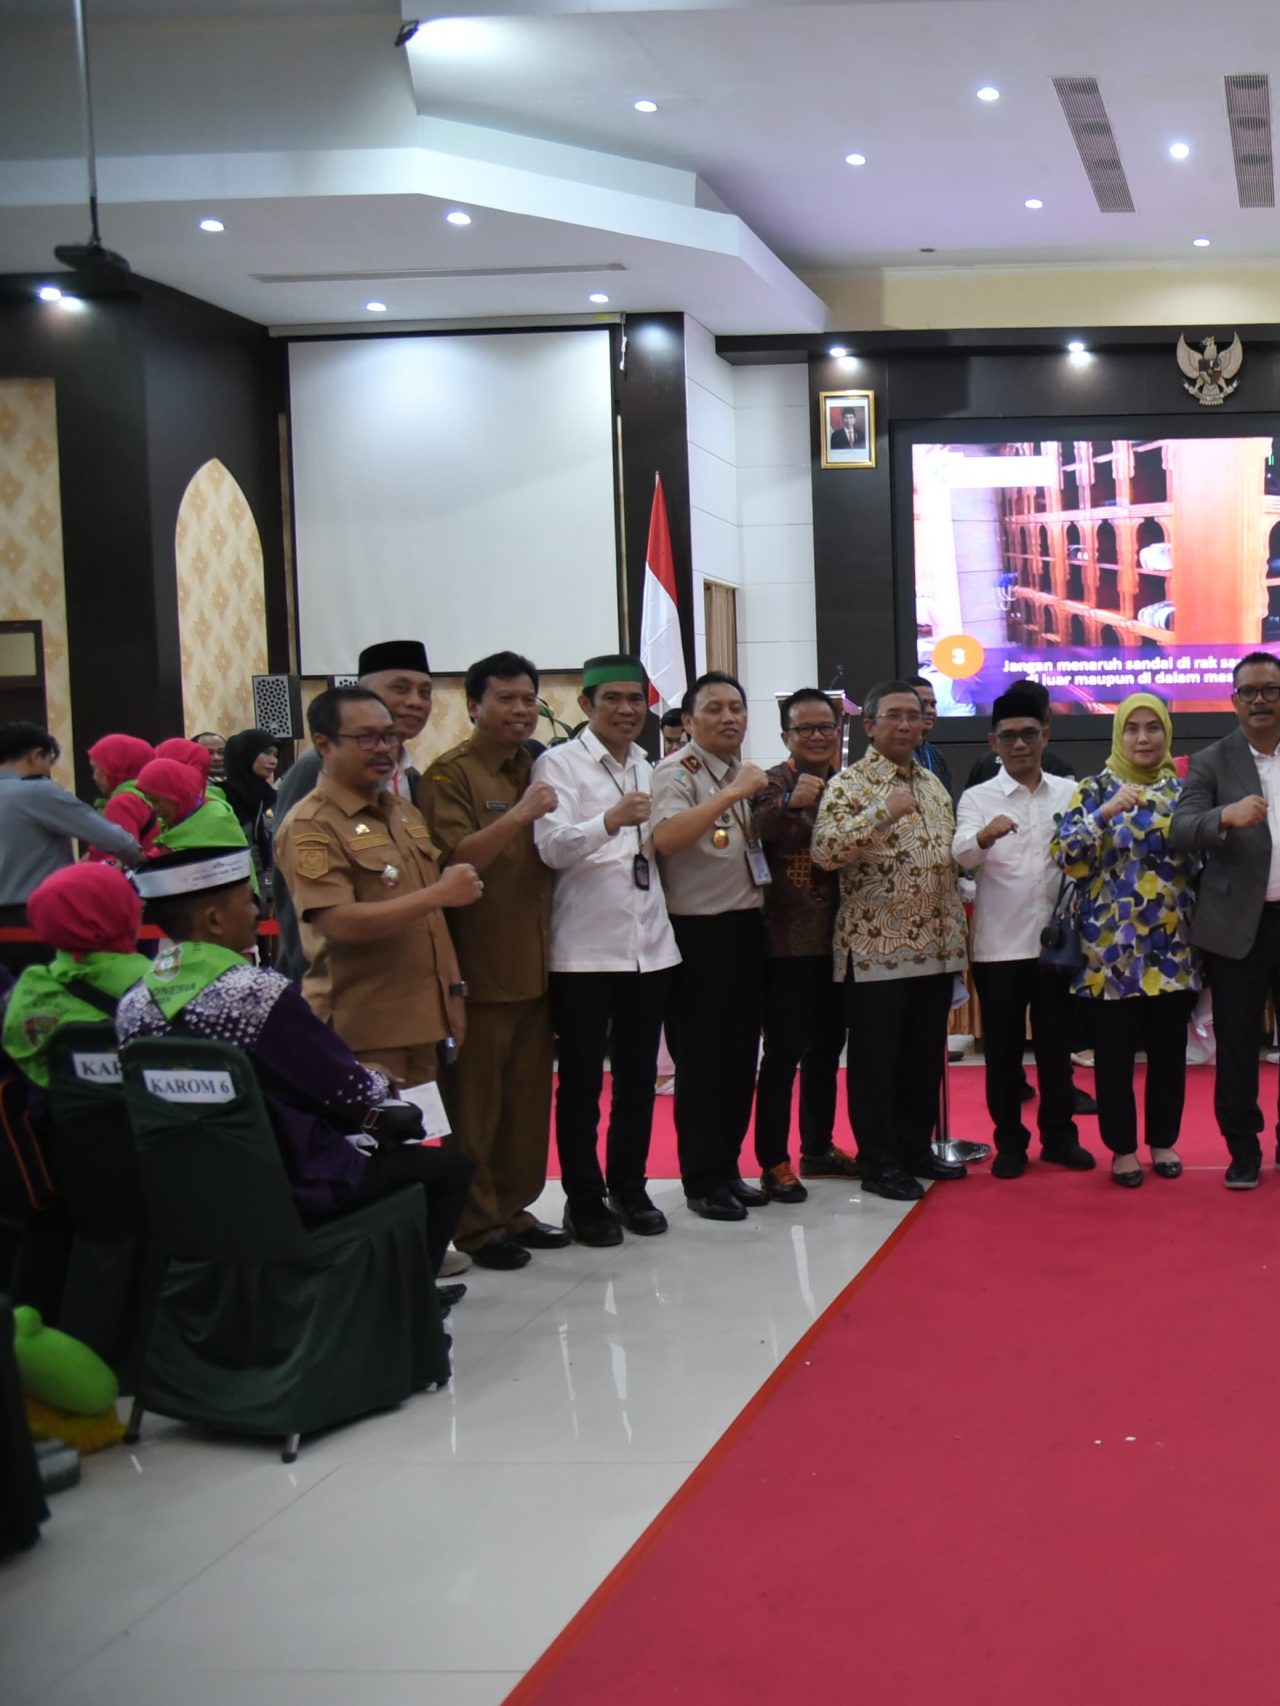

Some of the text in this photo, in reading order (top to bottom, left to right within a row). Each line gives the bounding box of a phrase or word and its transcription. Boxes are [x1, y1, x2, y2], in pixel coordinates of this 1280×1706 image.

[951, 648, 965, 665] 3
[1003, 660, 1053, 675] Jangan
[1056, 657, 1123, 672] menaruh
[1125, 656, 1174, 671] sandal
[1176, 656, 1191, 670] di
[1193, 655, 1218, 670] rak
[1041, 672, 1071, 686] luar
[1074, 673, 1135, 687] maupun
[1137, 671, 1152, 685] di
[1154, 670, 1201, 685] dalam
[151, 1078, 230, 1095] KAROM 6
